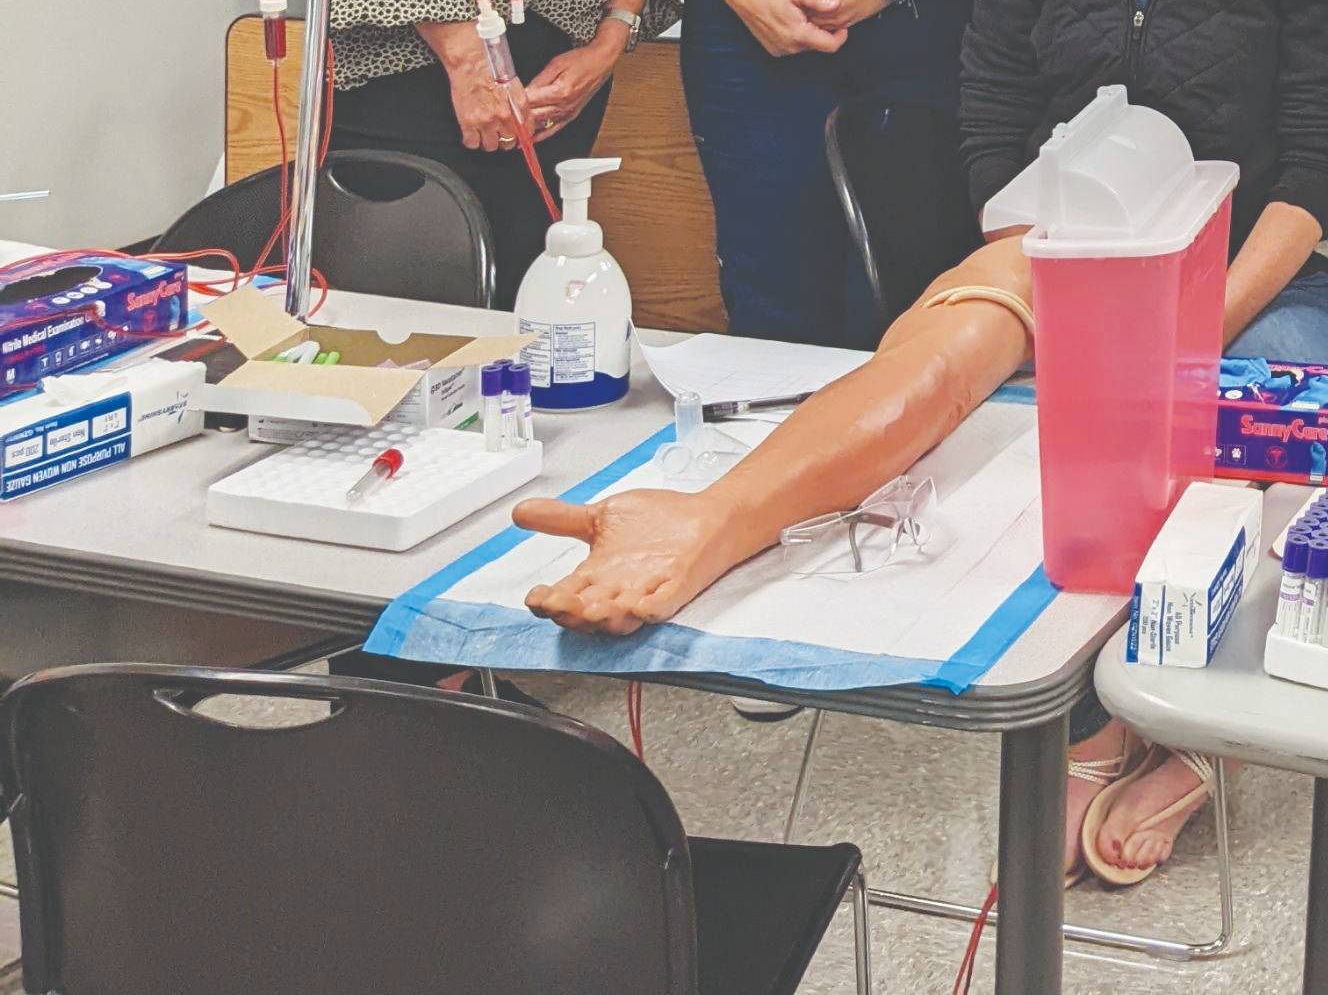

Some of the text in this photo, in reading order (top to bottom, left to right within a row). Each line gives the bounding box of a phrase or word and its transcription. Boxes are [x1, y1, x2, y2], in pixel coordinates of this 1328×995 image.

[3, 316, 85, 354] Nitrile Medical Examination
[6, 367, 16, 382] M
[5, 442, 126, 492] ALL PURPOSE NON WOVEN GAUZE
